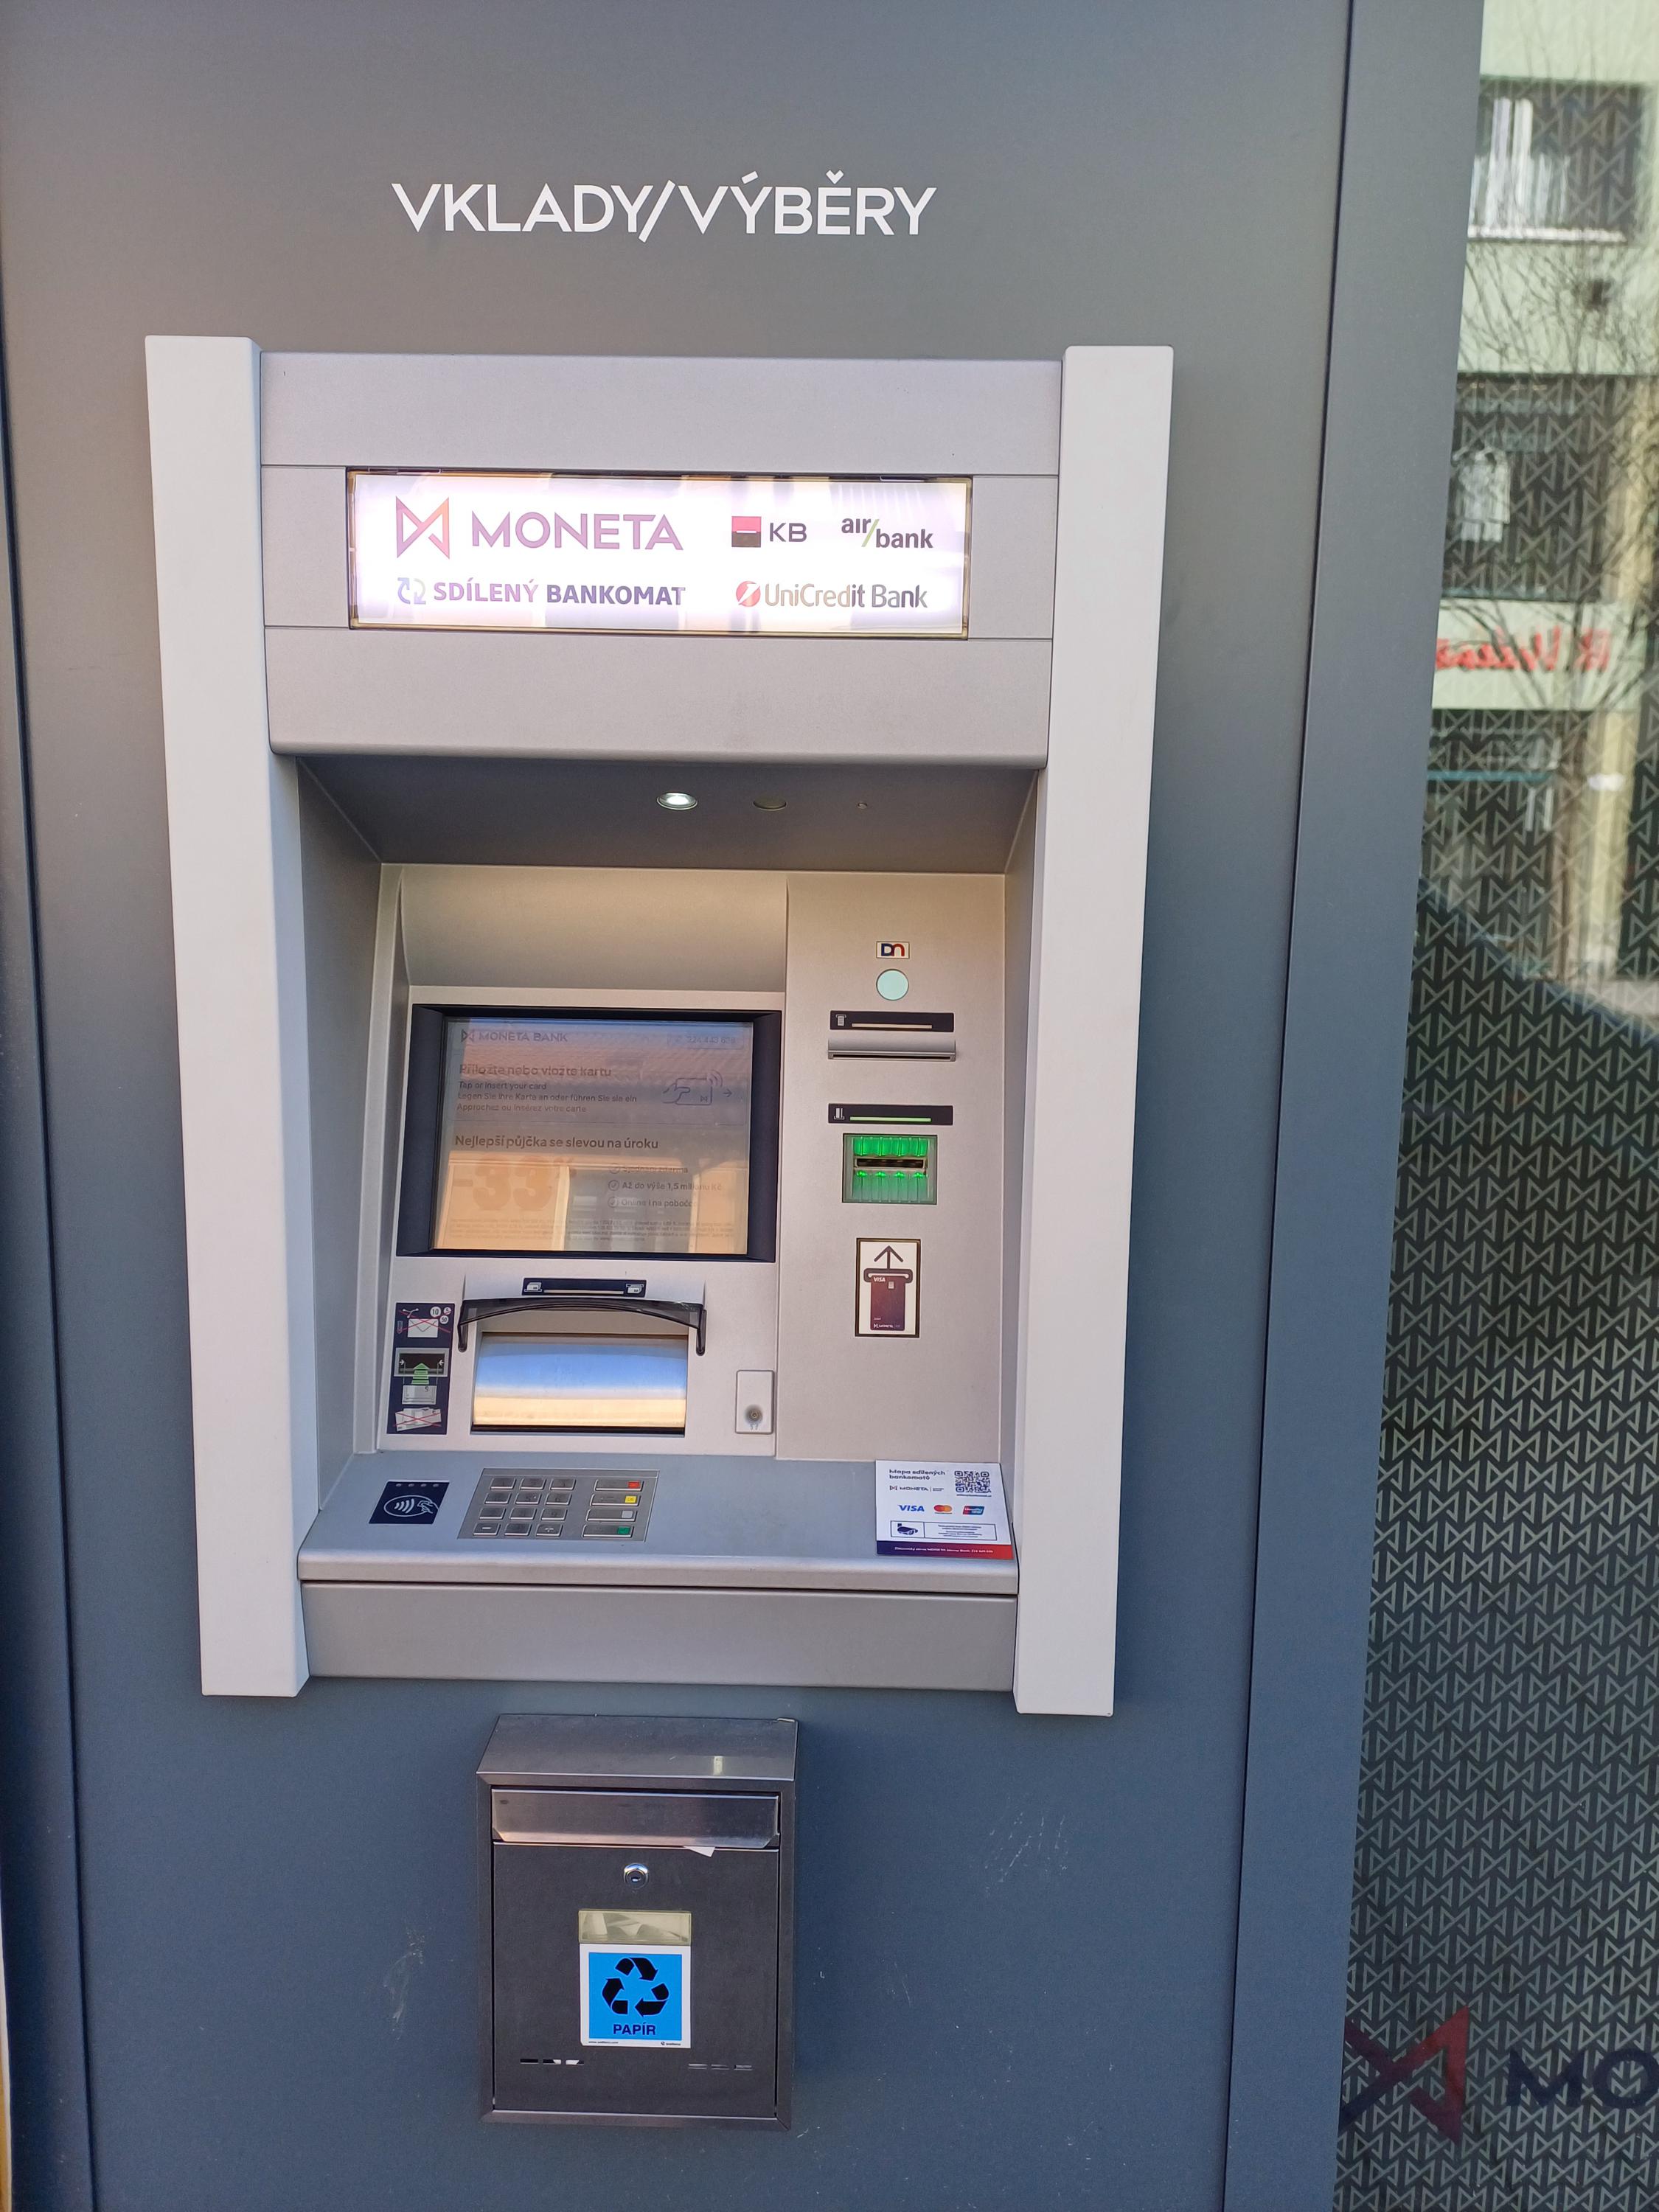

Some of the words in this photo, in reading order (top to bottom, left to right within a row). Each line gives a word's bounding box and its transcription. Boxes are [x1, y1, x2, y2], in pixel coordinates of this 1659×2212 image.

[471, 512, 684, 552] MONETA
[769, 522, 808, 543] KB
[434, 578, 539, 603] SDÍLENÝ
[546, 585, 686, 606] BANKOMAT
[765, 582, 866, 609] UniCredit
[871, 585, 928, 608] Bank
[479, 1031, 530, 1043] MONETA
[533, 1032, 568, 1043] BANK
[580, 1066, 612, 1077] kartu
[459, 1081, 473, 1091] Tap
[509, 1082, 527, 1091] your
[529, 1082, 547, 1090] card
[550, 1093, 569, 1102] oder
[454, 1134, 505, 1150] Nejlepší
[506, 1135, 547, 1152] půjčka
[549, 1139, 563, 1148] se
[565, 1138, 605, 1149] slevou
[607, 1140, 622, 1149] na
[624, 1138, 660, 1150] úroku
[622, 1181, 633, 1190] Až
[634, 1182, 645, 1190] do
[647, 1182, 666, 1192] výše
[667, 1182, 680, 1192] 1,5
[613, 2022, 656, 2036] PAPÍR
